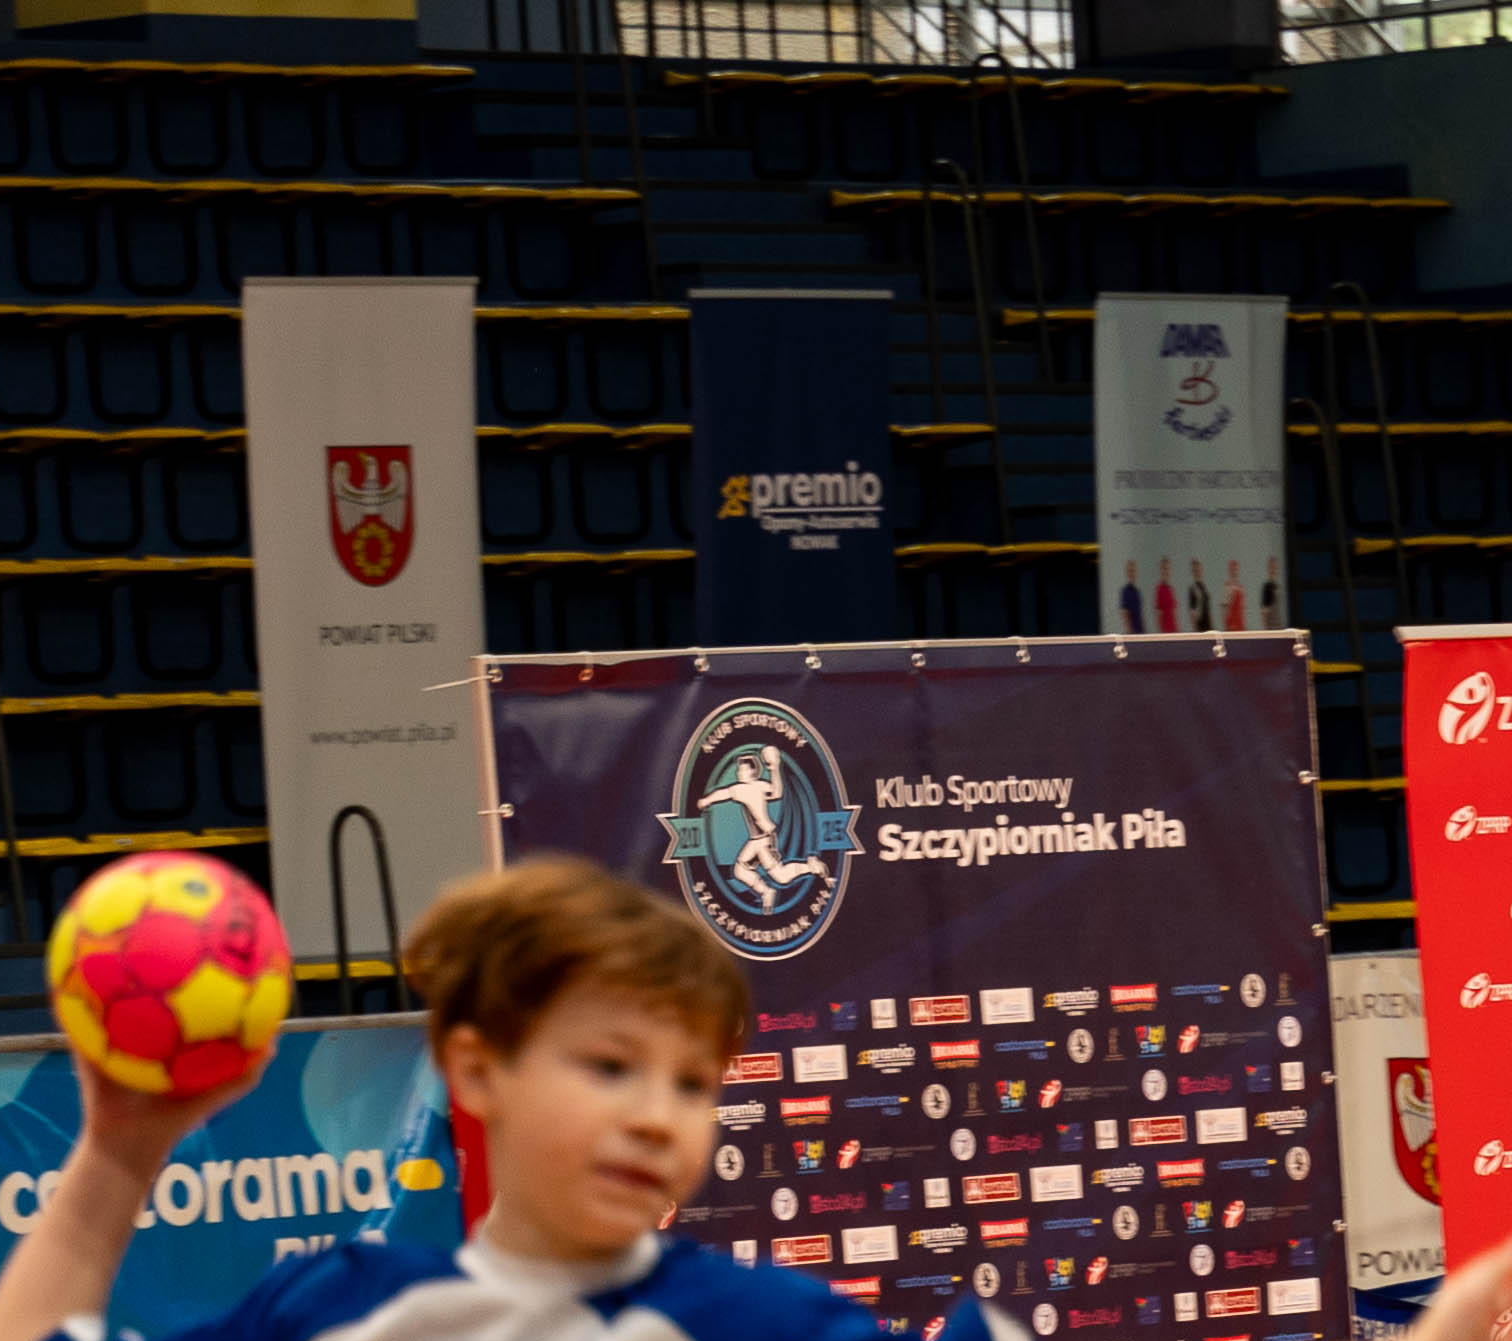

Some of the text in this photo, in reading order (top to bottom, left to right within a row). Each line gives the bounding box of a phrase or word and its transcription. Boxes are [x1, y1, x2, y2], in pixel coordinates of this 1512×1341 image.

[751, 460, 882, 518] premio
[319, 623, 437, 646] POWIAT PILSKI
[876, 775, 1074, 813] Klub Sportowy
[878, 808, 1187, 867] Szczypiorniak Piła
